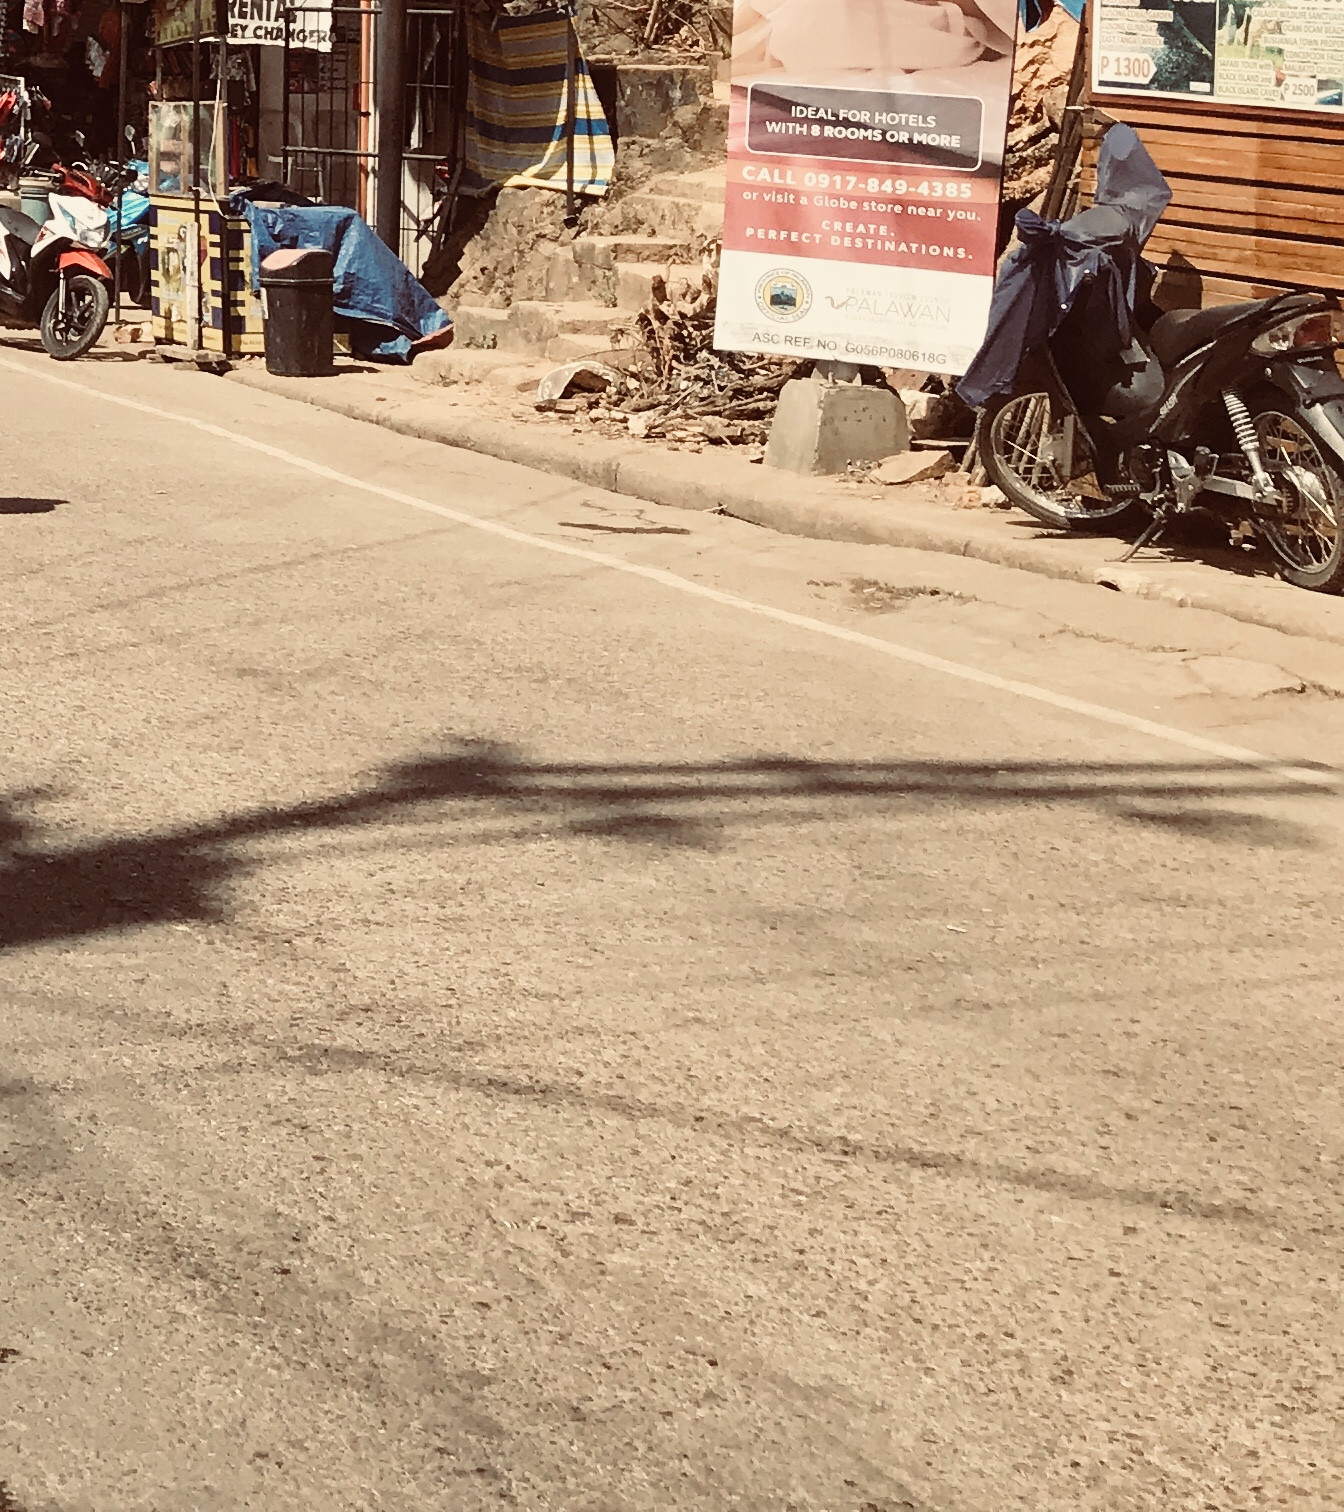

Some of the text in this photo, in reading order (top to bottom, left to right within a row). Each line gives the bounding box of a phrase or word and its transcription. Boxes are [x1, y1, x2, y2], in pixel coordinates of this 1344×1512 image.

[1114, 56, 1150, 78] 1300
[1292, 83, 1315, 97] 2500
[791, 105, 936, 128] IDEAL FOR HOTELS
[765, 121, 961, 148] WITH 8 ROOMS OR MORE
[741, 165, 973, 199] CALL 0917-849-4385
[742, 190, 981, 223] or visit a Globe store near you.
[821, 220, 896, 236] CREATE.
[745, 227, 973, 260] PERFECT DESTINATIONS.
[845, 295, 951, 323] PALAWAN
[752, 332, 947, 364] ASC REF NO G056P080618G
